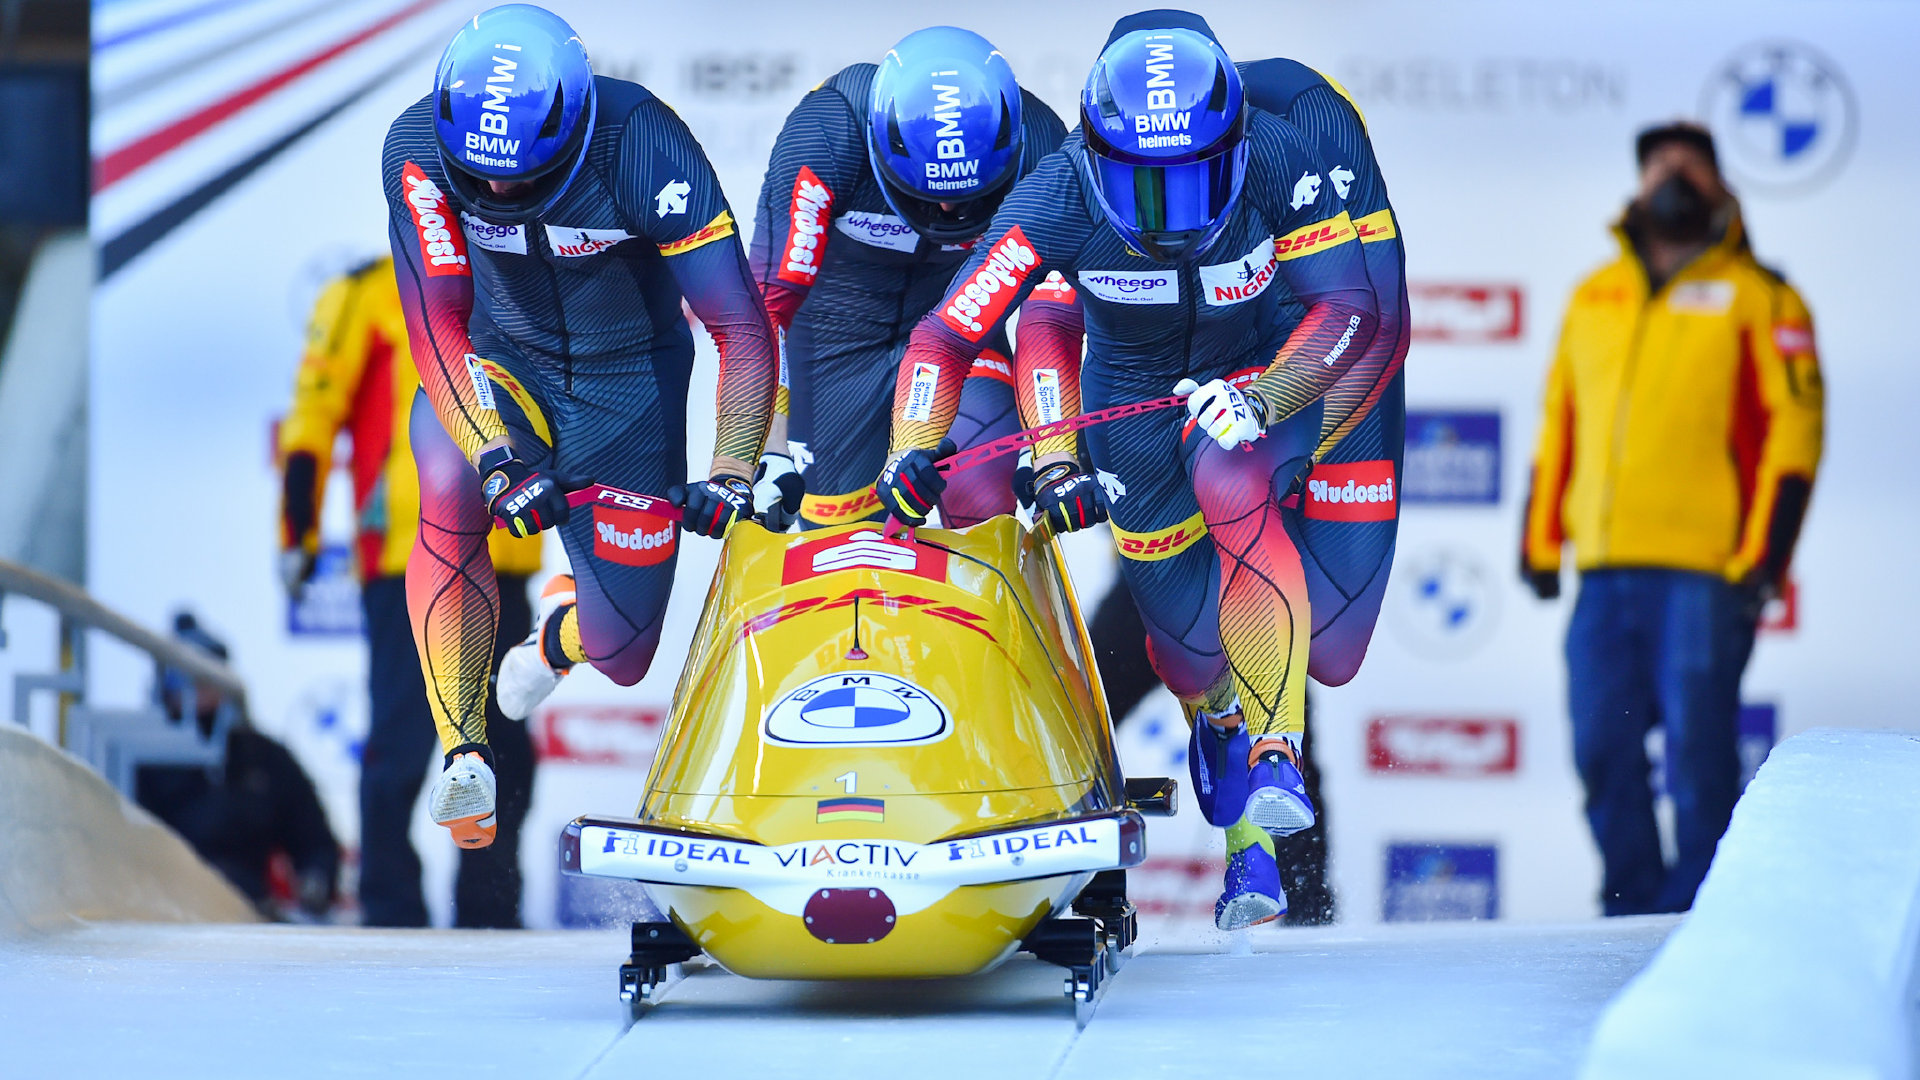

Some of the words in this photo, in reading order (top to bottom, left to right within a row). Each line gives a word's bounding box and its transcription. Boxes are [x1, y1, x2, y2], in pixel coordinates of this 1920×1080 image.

[1145, 44, 1176, 110] BMW
[480, 56, 518, 135] BMW
[932, 84, 965, 160] BMW
[1135, 112, 1191, 133] BMW
[465, 131, 520, 155] BMW
[1138, 133, 1192, 149] helmets
[466, 150, 518, 168] helmets
[925, 159, 980, 178] BMW
[928, 178, 979, 190] helmets
[848, 217, 912, 235] wheego
[1274, 225, 1338, 254] DHL
[947, 238, 1035, 332] Nudossi
[1088, 275, 1168, 289] wheego
[1223, 384, 1246, 421] SEIZ
[706, 483, 746, 510] SEIZ
[1054, 474, 1092, 497] SEIZ
[1309, 477, 1393, 503] Nudossi
[506, 482, 543, 515] SEIZ
[598, 489, 653, 510] FES
[597, 520, 673, 550] Nudossi
[1121, 528, 1191, 554] DHL
[791, 676, 922, 701] BMW
[835, 771, 857, 794] 1
[647, 838, 750, 865] IDEAL
[992, 826, 1097, 855] IDEAL
[773, 843, 919, 867] VIACTIV
